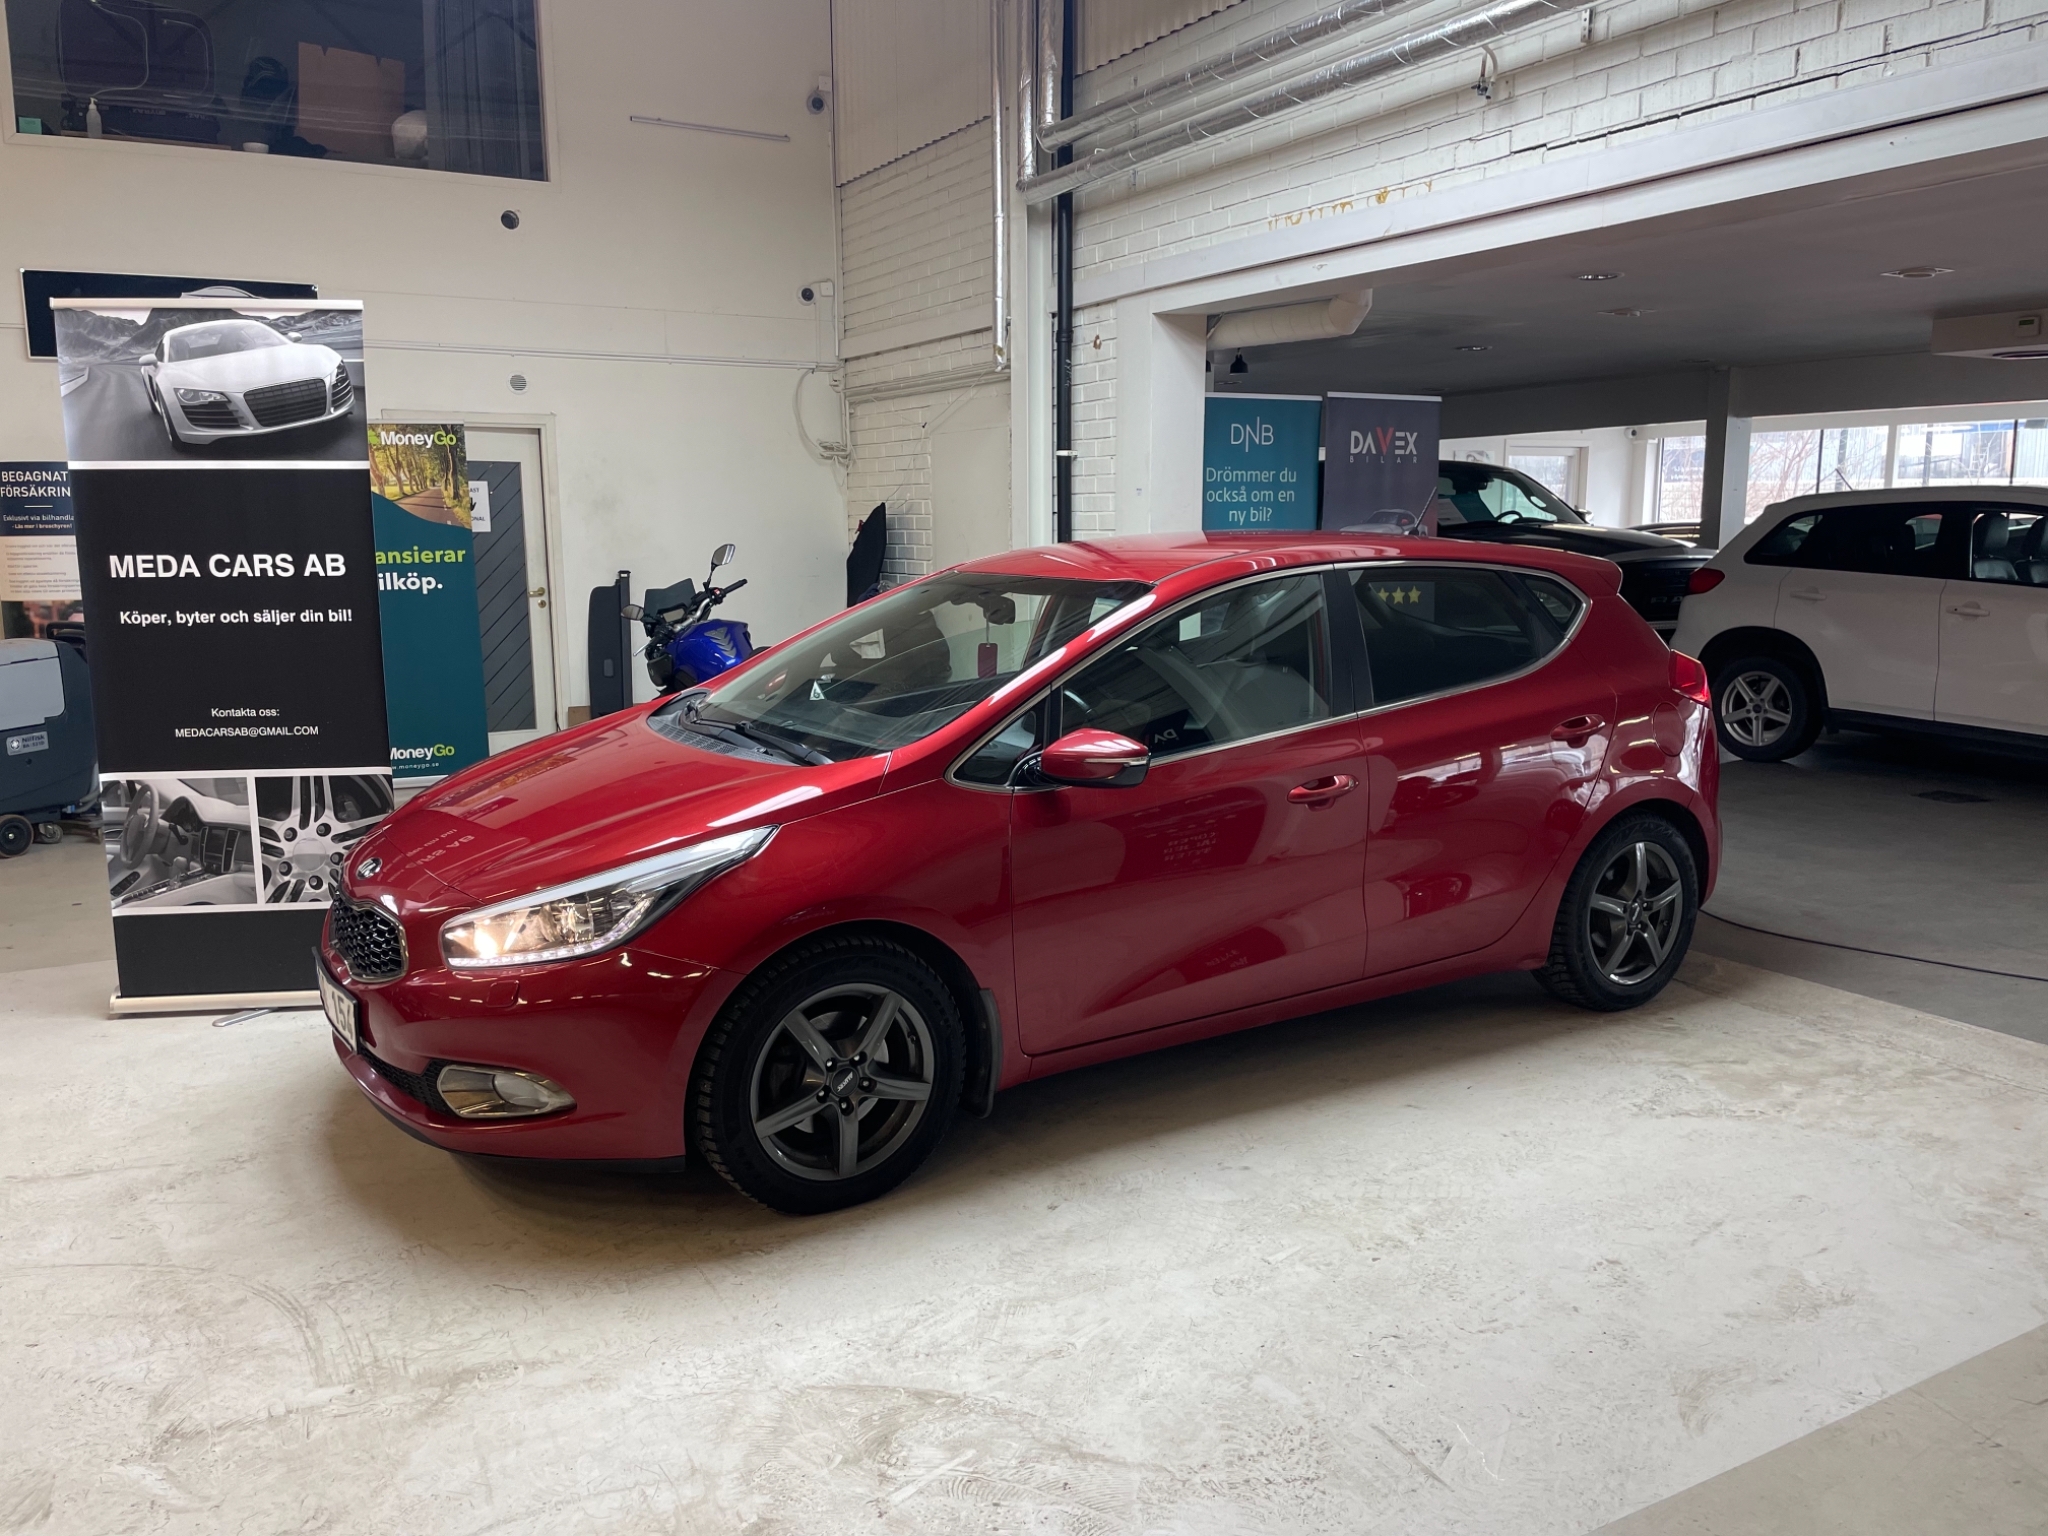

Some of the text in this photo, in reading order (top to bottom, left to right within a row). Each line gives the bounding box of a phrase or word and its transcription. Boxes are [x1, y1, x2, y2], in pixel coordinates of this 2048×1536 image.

[380, 431, 457, 448] MoneyGo
[1230, 416, 1274, 453] DNB
[1350, 426, 1418, 456] DAVEX
[1349, 455, 1418, 464] BILAR
[1, 471, 69, 482] BEGAGNAT
[1206, 466, 1297, 482] Drömmer du
[0, 484, 71, 498] FÖRSÄKRIN
[1206, 485, 1295, 502] också om en
[1228, 506, 1273, 526] ny bil?
[375, 545, 466, 565] ansierar
[109, 553, 346, 578] MEDA CARS AB
[378, 572, 443, 595] ilköp.
[120, 609, 352, 627] Köper, byter och säljer din bil!
[211, 707, 280, 717] Kontakta oss:
[175, 726, 319, 738] MEDACARSAB@GMAIL.COM
